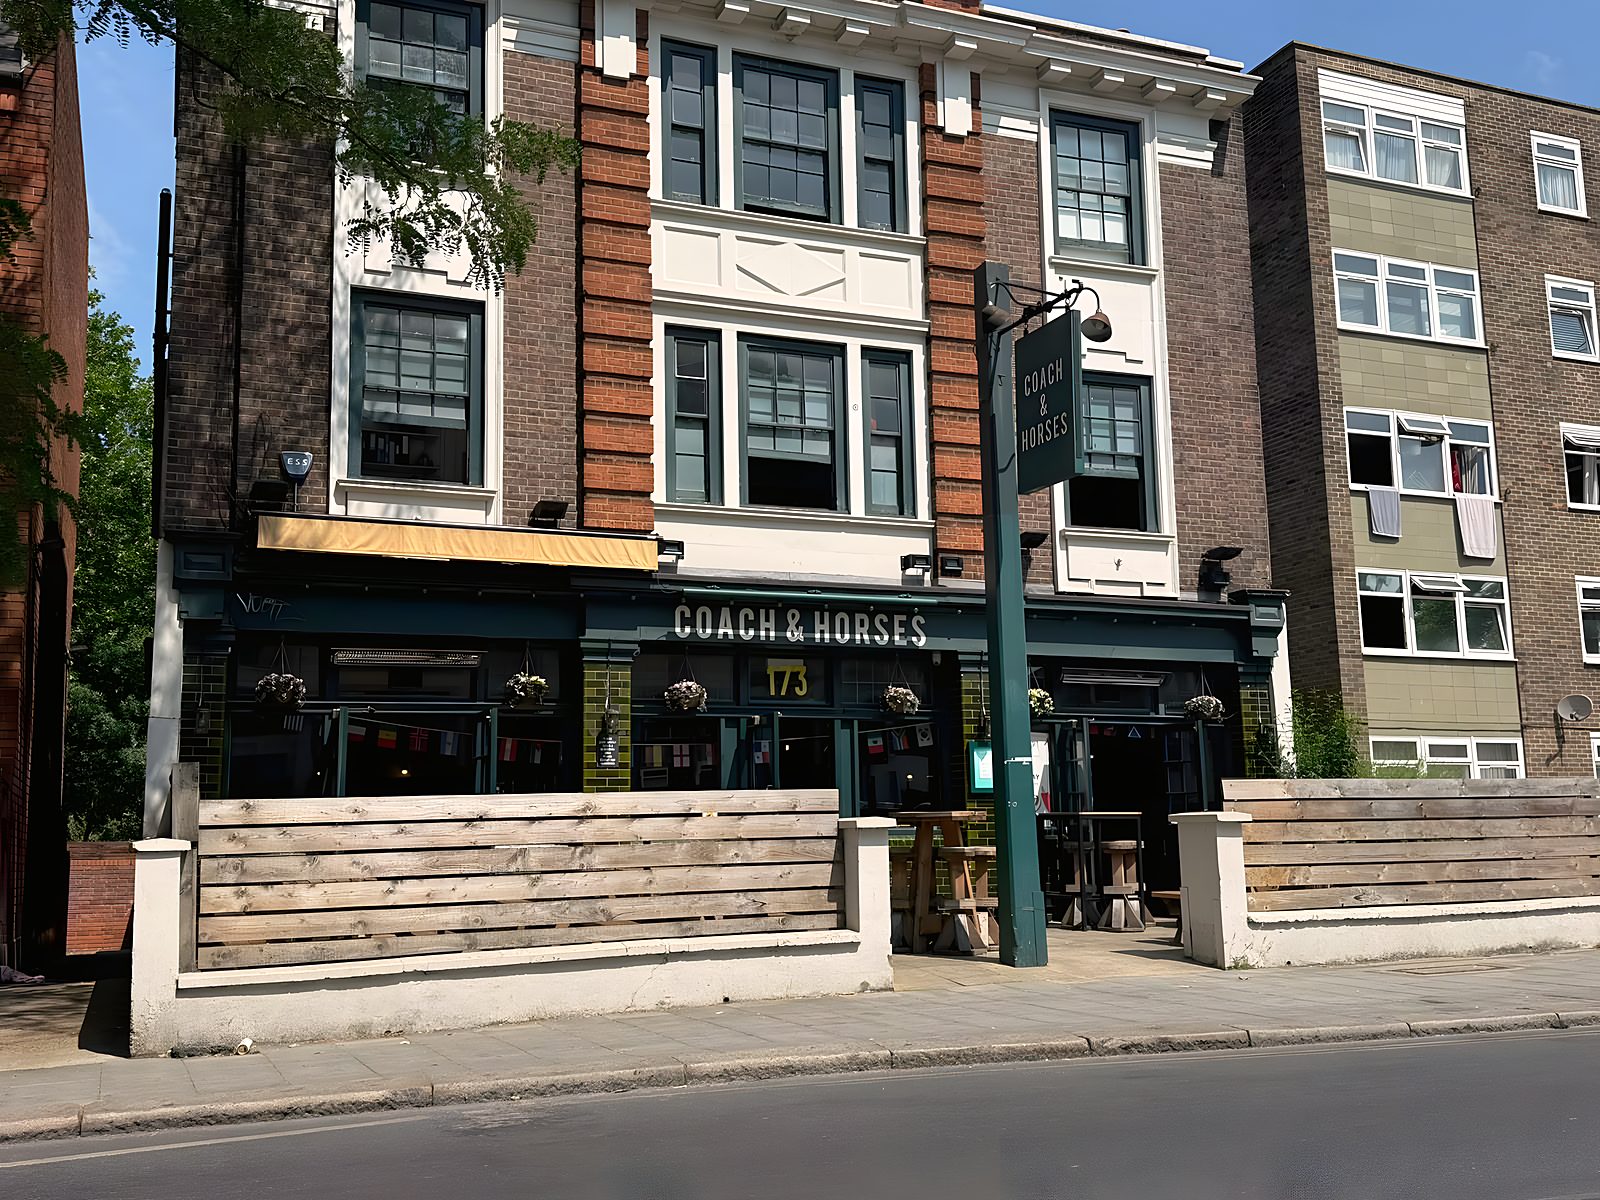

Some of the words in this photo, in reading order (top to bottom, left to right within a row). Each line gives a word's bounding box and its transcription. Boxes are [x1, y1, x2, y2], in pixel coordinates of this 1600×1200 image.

[1024, 357, 1063, 396] COACH
[1040, 394, 1048, 417] &
[1021, 411, 1068, 452] HORSES
[287, 457, 308, 466] ESS
[674, 605, 775, 641] COACH
[786, 608, 804, 642] &
[814, 610, 927, 647] HORSES
[767, 665, 807, 696] 173
